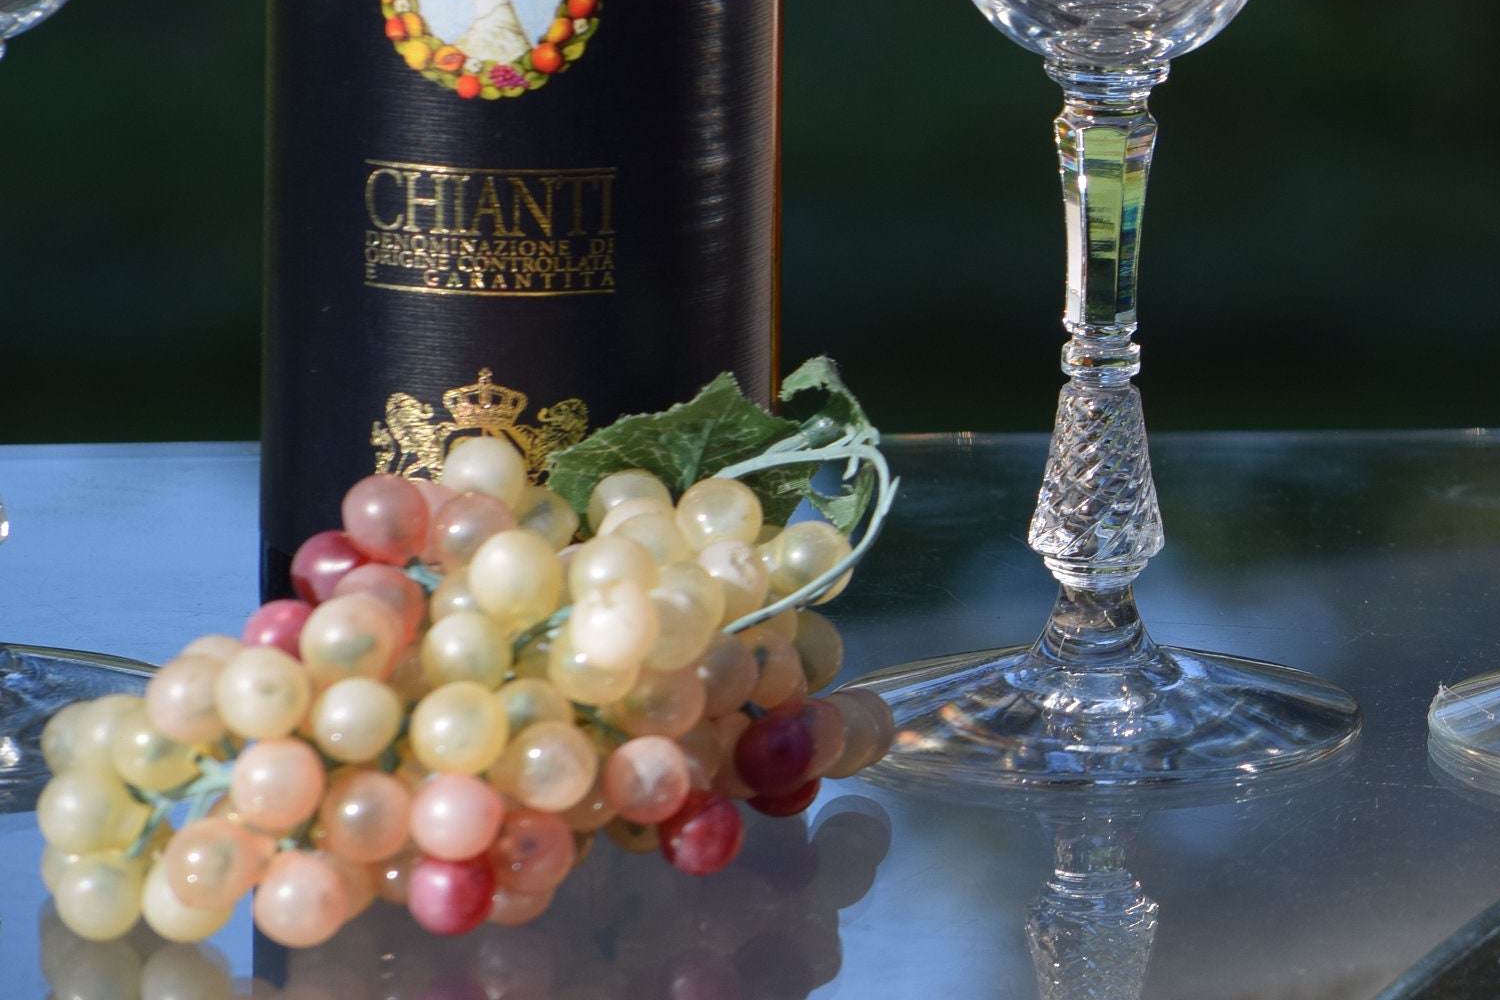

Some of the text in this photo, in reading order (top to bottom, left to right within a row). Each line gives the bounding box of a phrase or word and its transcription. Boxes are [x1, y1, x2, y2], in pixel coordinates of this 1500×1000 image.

[364, 168, 615, 237] CHIANTI
[365, 230, 615, 256] DENOMINAZIONE DI
[365, 246, 615, 273] ORIGINE CONTROLLATA
[365, 262, 616, 289] E GARANTITA
